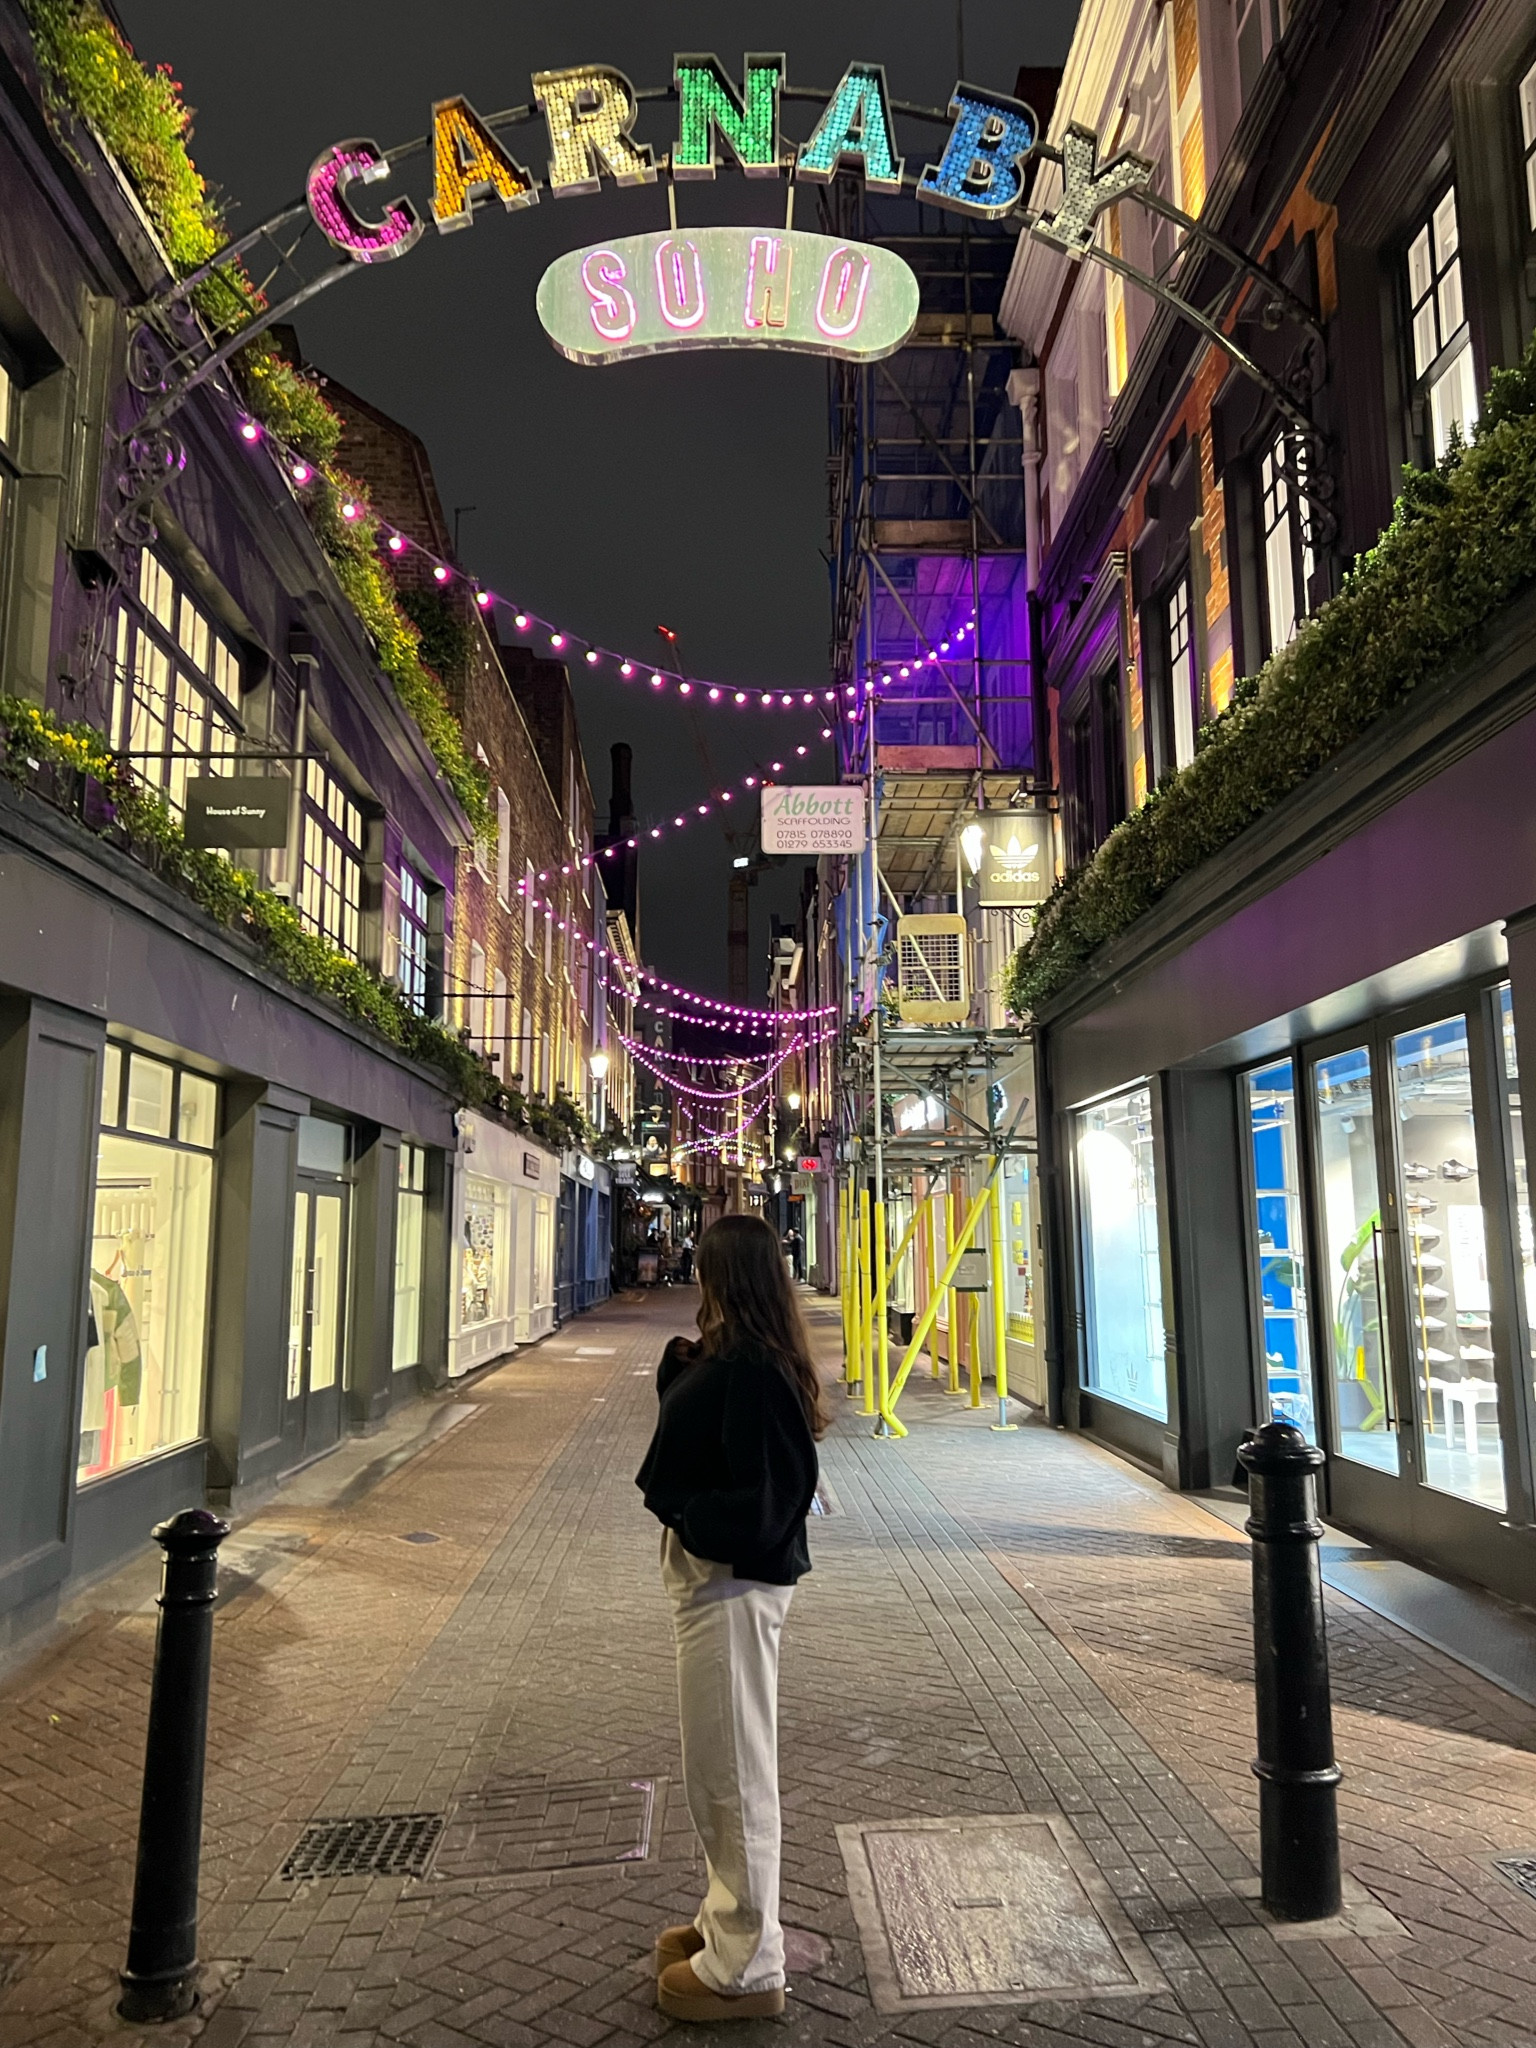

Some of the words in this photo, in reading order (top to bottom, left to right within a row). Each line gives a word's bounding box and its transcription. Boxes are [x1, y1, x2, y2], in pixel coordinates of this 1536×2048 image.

[306, 52, 1154, 264] CARNABY
[581, 236, 871, 340] SOHO
[773, 792, 854, 816] Abbott
[206, 806, 230, 815] House
[231, 806, 240, 815] of
[241, 806, 266, 818] Sunny
[777, 817, 851, 826] SCAFFOLDING
[776, 830, 807, 839] 07815
[810, 830, 853, 839] 078890
[776, 840, 808, 849] 01279
[812, 840, 853, 849] 653345
[990, 868, 1040, 883] adidas
